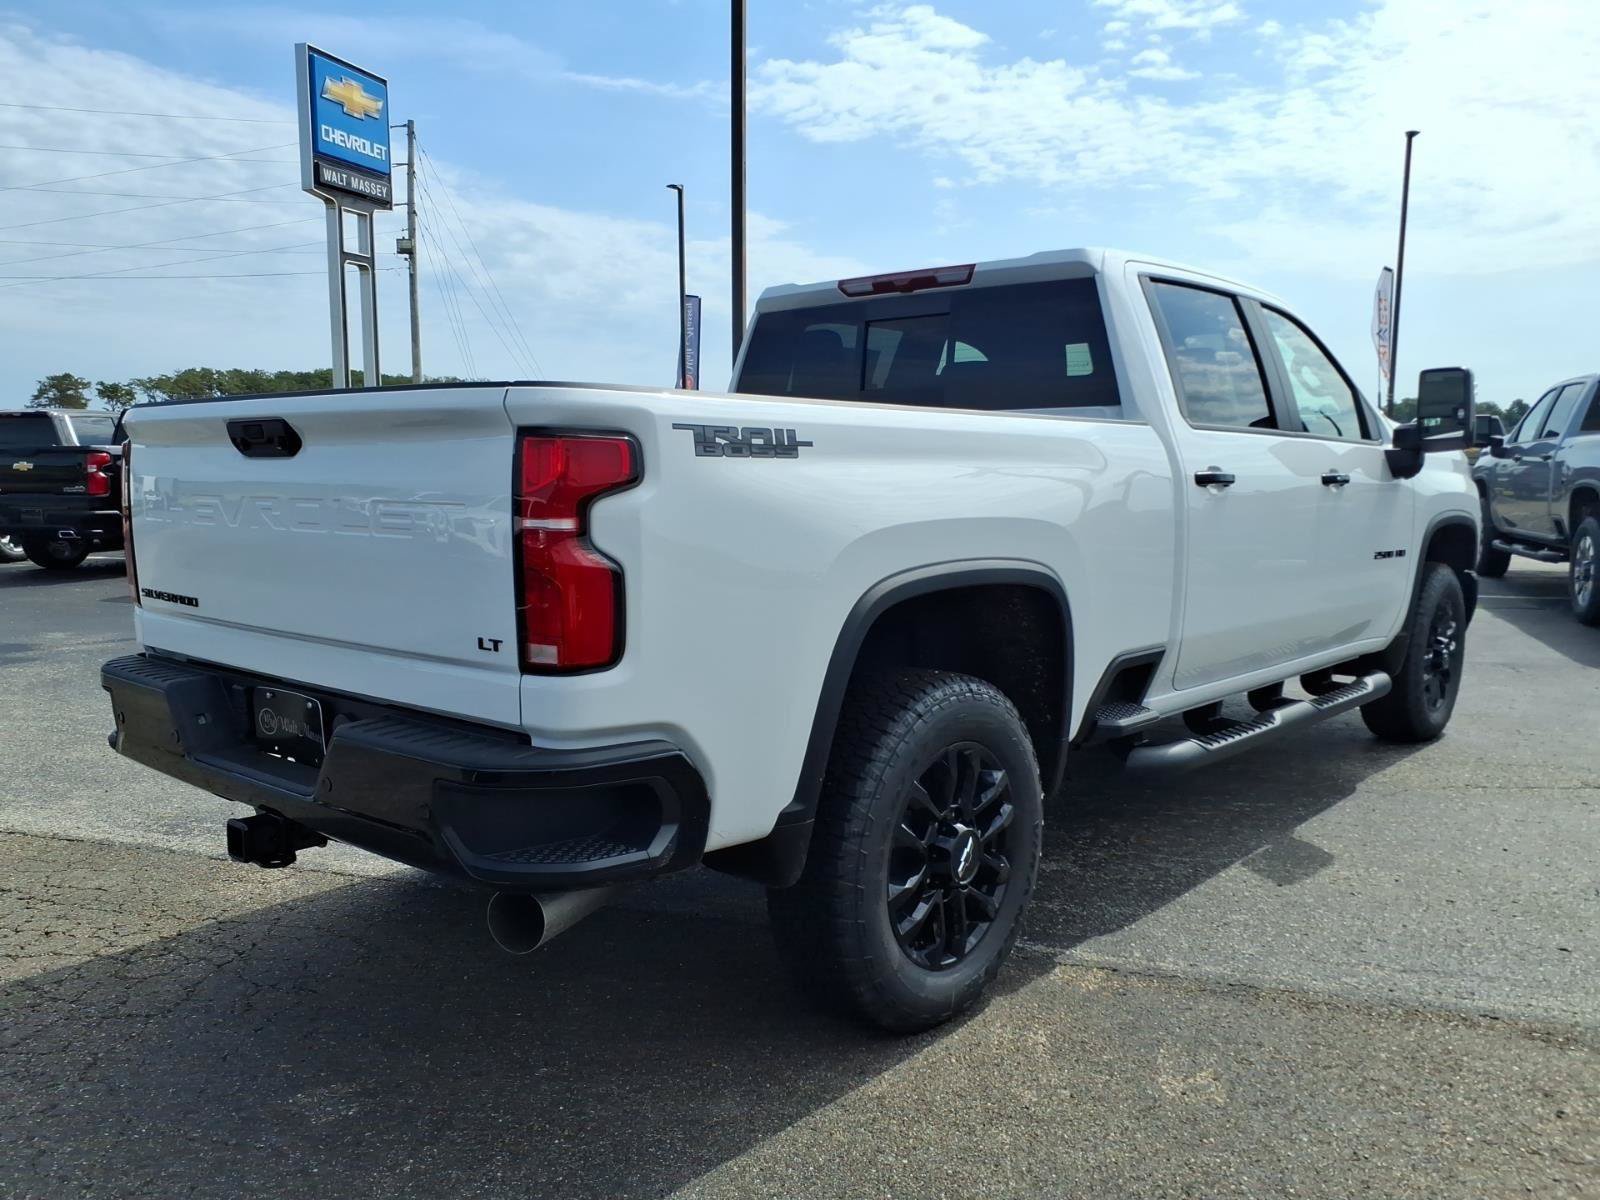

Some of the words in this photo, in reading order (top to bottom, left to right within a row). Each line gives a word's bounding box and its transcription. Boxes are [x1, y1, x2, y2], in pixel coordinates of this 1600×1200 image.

[321, 124, 387, 161] CHEVROLET
[323, 167, 347, 187] WALT
[351, 176, 388, 198] MASSEY
[672, 422, 813, 448] TRAIL
[695, 441, 799, 459] BOSS
[141, 588, 199, 608] SILVERADO
[477, 637, 503, 652] LT
